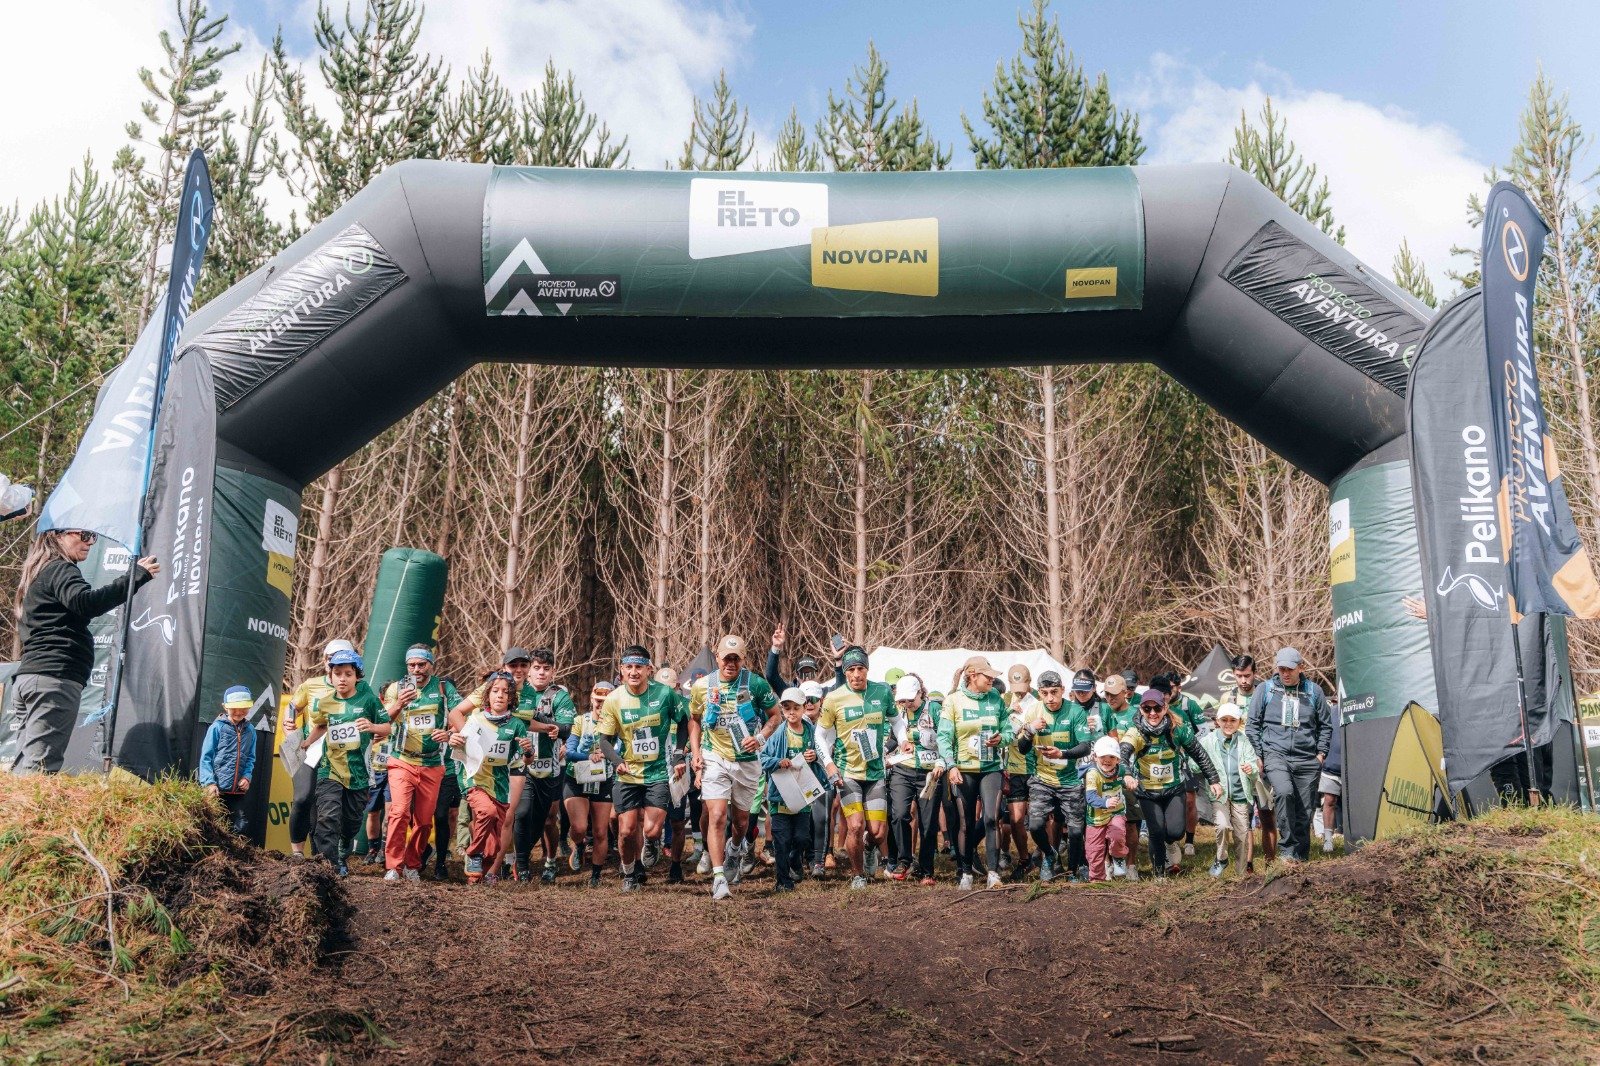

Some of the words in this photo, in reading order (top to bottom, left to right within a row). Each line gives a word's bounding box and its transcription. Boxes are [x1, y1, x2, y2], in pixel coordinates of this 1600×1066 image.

[718, 190, 754, 206] EL
[718, 207, 800, 227] RETO
[822, 249, 928, 265] NOVOPAN
[537, 280, 577, 288] PROYECTO
[1072, 279, 1111, 287] NOVOPAN
[537, 288, 598, 298] AVENTURA
[1303, 272, 1372, 319] PROYECTO
[248, 273, 352, 355] AVENTURA
[1288, 282, 1400, 358] AVENTURA
[1515, 292, 1551, 537] AVENTURA
[1460, 425, 1500, 564] Pelikano
[275, 515, 285, 528] EL
[166, 467, 195, 605] Pelikano
[273, 526, 293, 544] RETO
[187, 497, 204, 595] NOVOPAN
[182, 553, 190, 579] MARCA
[414, 715, 432, 726] 815
[331, 726, 357, 741] 832
[634, 741, 657, 753] 760
[1152, 766, 1171, 776] 873
